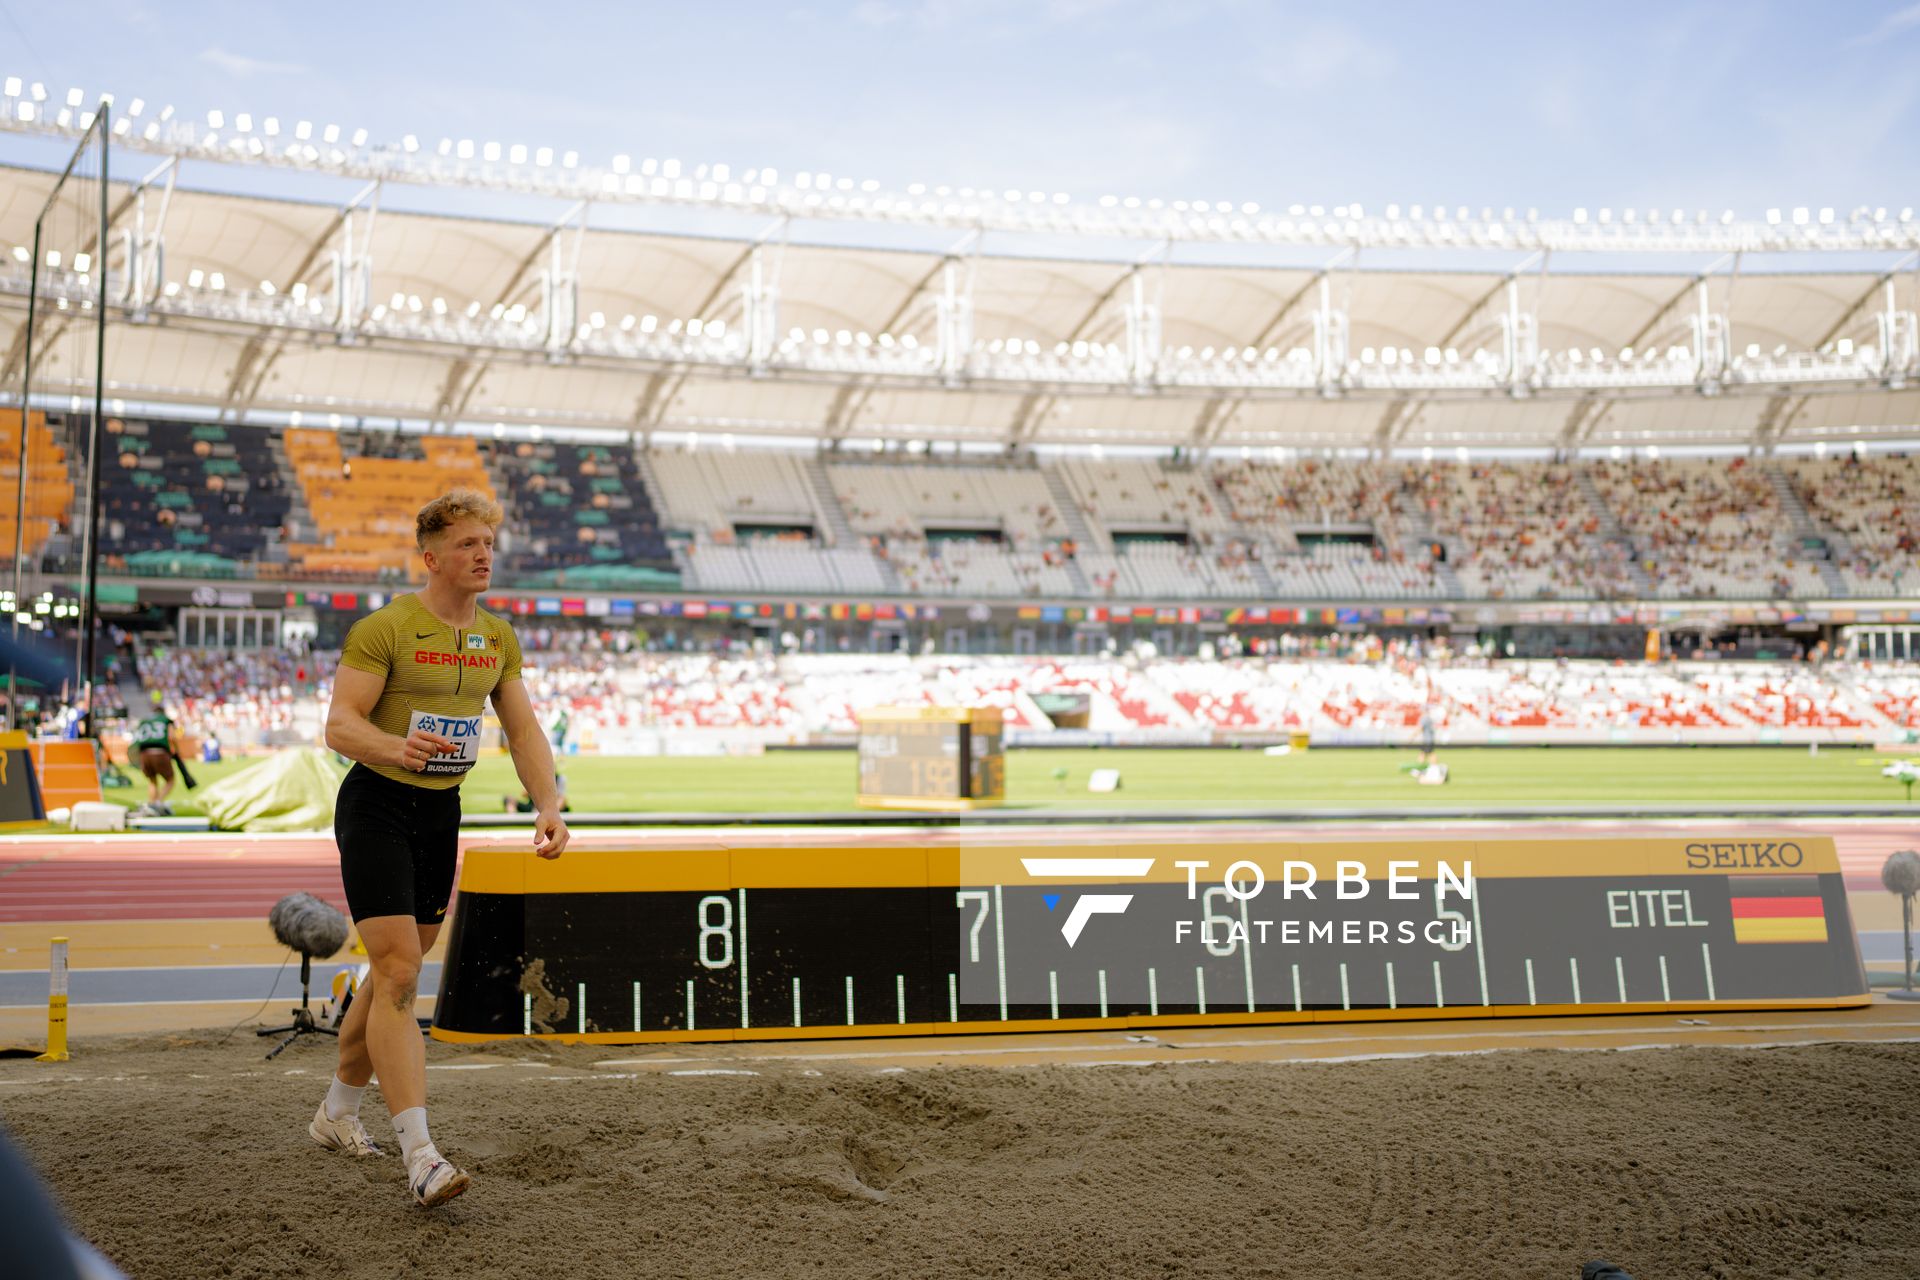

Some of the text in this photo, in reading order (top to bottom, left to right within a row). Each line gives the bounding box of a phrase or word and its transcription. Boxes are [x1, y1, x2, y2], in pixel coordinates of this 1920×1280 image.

[415, 650, 497, 670] GERMANY
[437, 717, 480, 737] TDK
[427, 764, 465, 773] BUDAPEST
[1685, 842, 1804, 869] SEIKO
[956, 891, 990, 963] 7
[1202, 886, 1239, 957] 6
[1434, 882, 1468, 951] 5
[1606, 889, 1709, 928] EITEL
[697, 895, 734, 970] 8
